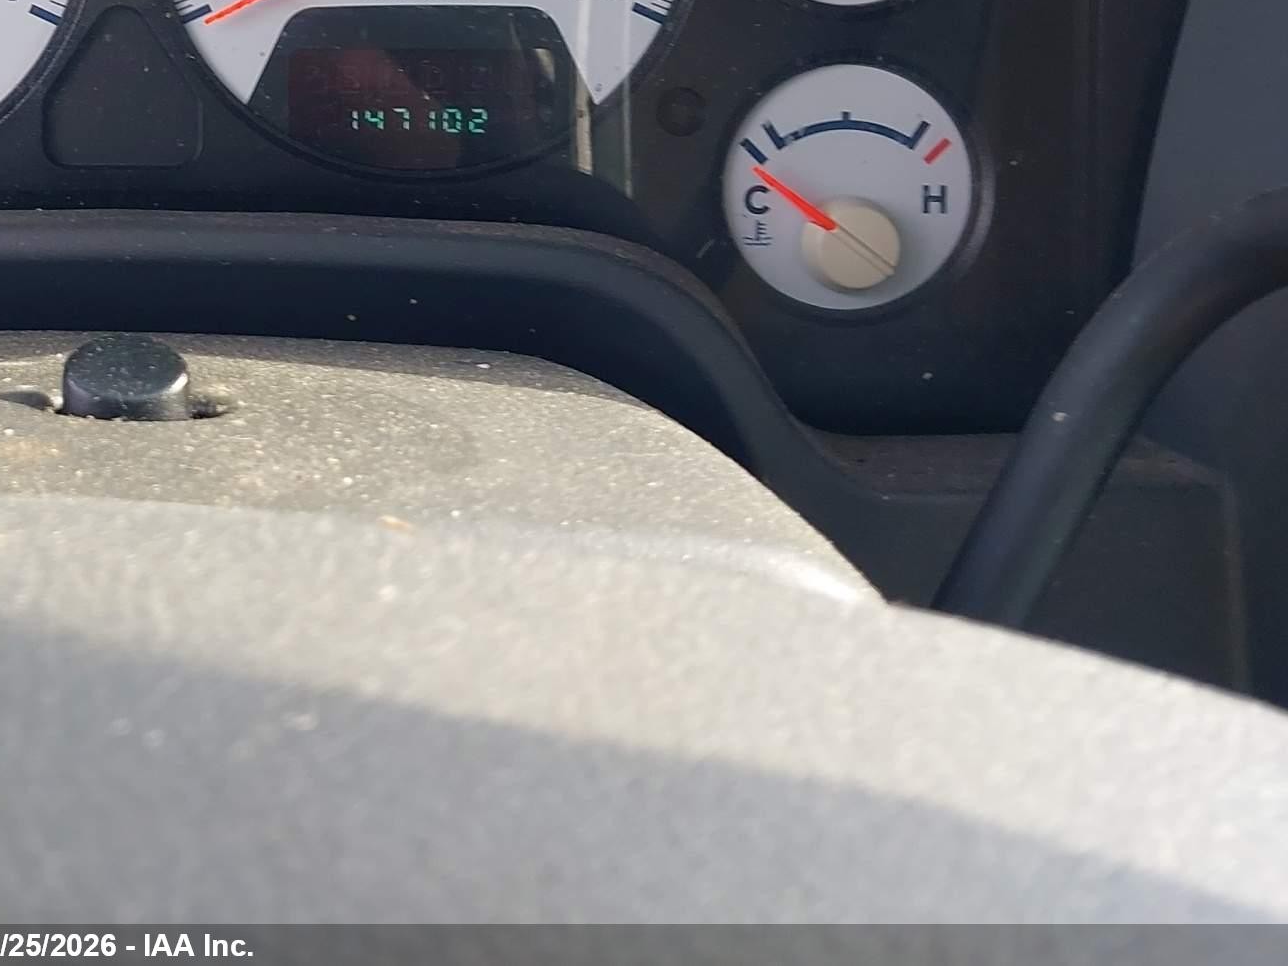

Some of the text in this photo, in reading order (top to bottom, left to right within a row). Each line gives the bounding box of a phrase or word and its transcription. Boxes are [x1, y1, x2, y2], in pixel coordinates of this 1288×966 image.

[351, 107, 488, 133] 147102
[744, 184, 770, 217] C
[922, 184, 947, 214] H
